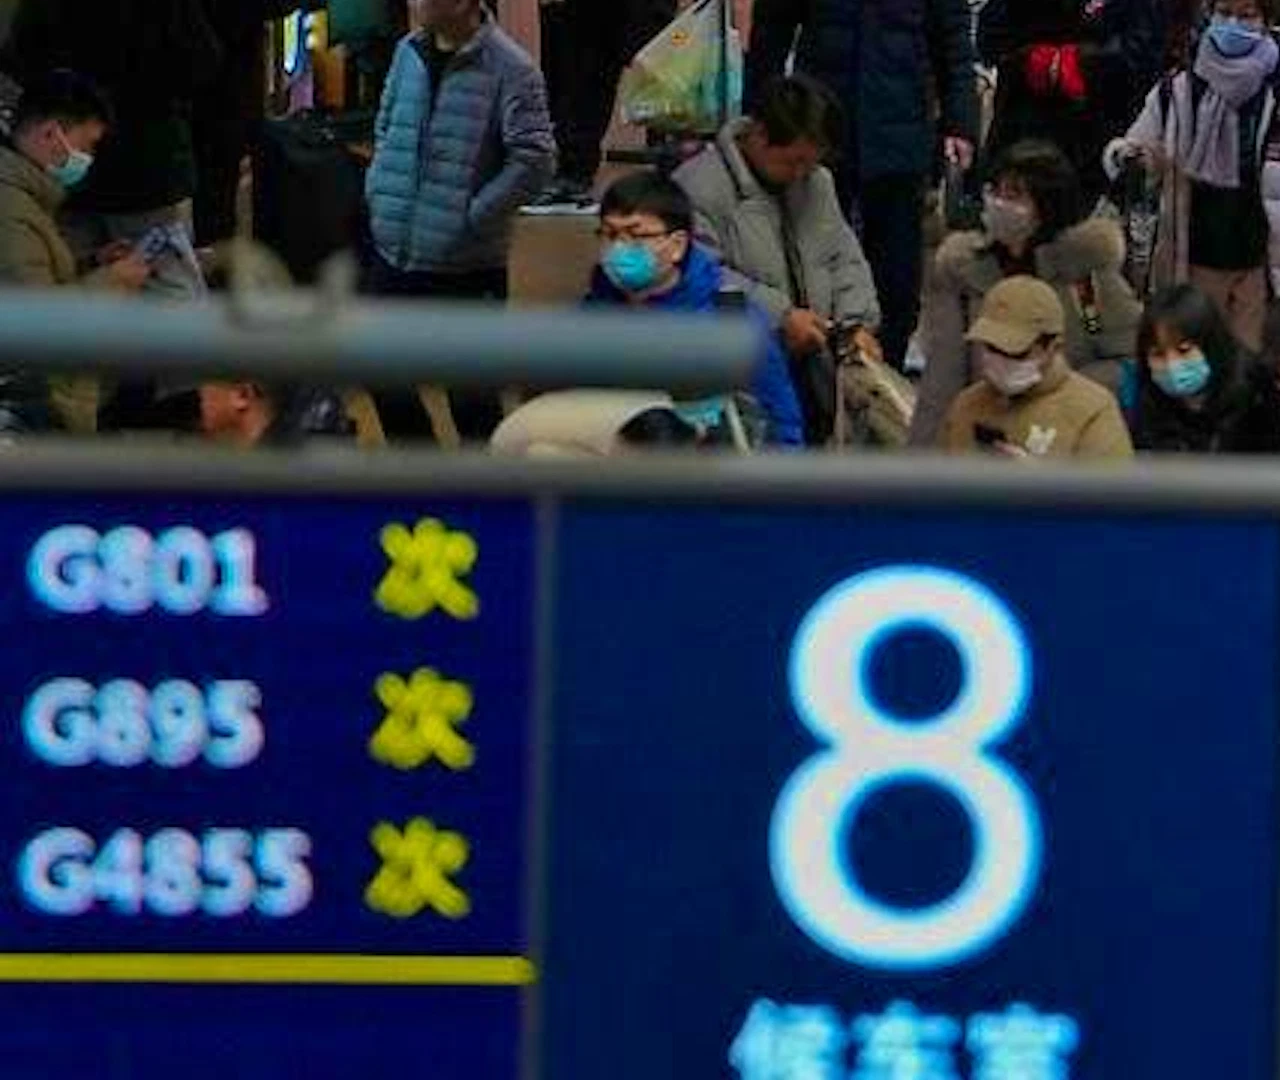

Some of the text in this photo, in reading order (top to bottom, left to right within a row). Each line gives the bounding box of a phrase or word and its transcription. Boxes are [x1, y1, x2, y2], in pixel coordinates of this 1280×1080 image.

[26, 518, 480, 619] G801 次
[21, 666, 475, 770] G895 次
[766, 563, 1046, 972] 8
[17, 816, 471, 919] G4855 次
